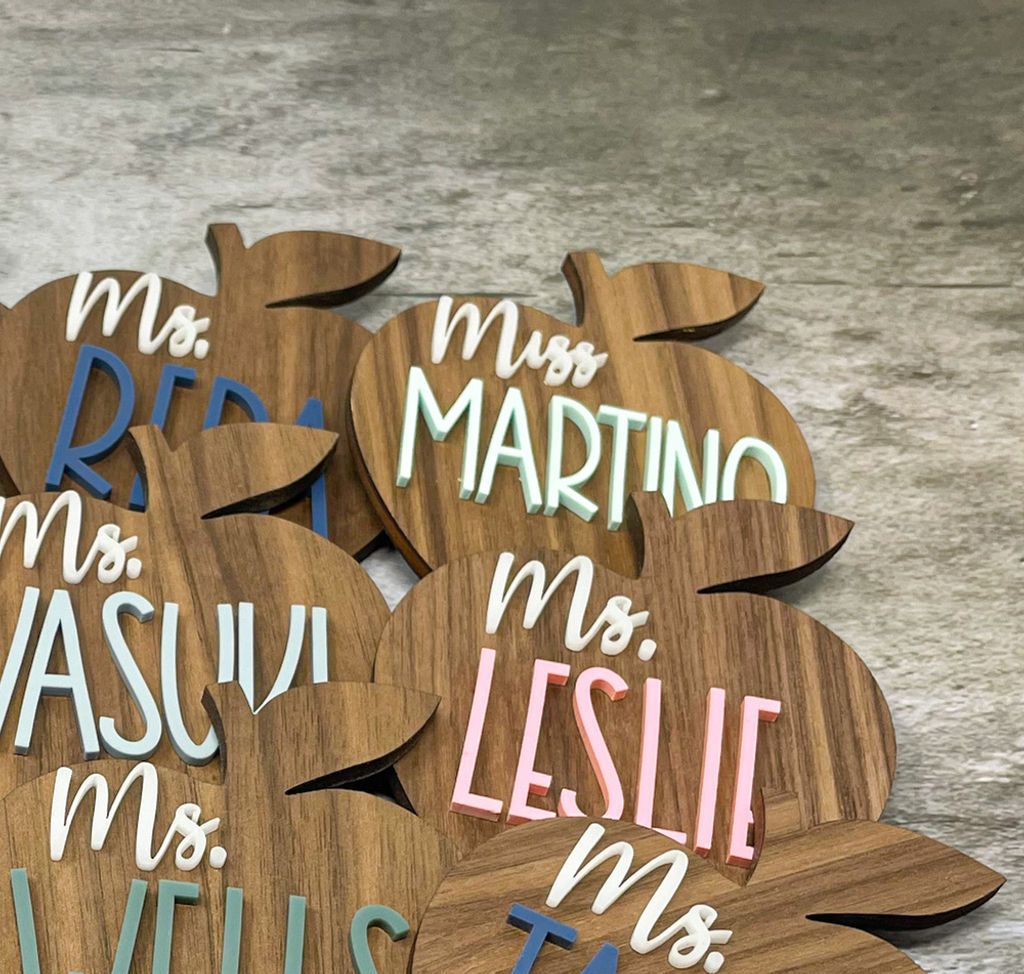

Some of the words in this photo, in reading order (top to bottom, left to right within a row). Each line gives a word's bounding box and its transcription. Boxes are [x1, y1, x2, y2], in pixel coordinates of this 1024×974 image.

[66, 271, 211, 359] Ms.
[431, 295, 609, 388] Miss
[485, 552, 657, 661] Ms.
[449, 647, 781, 867] LESLIE
[49, 762, 228, 871] Ms.
[545, 823, 734, 974] Ms.
